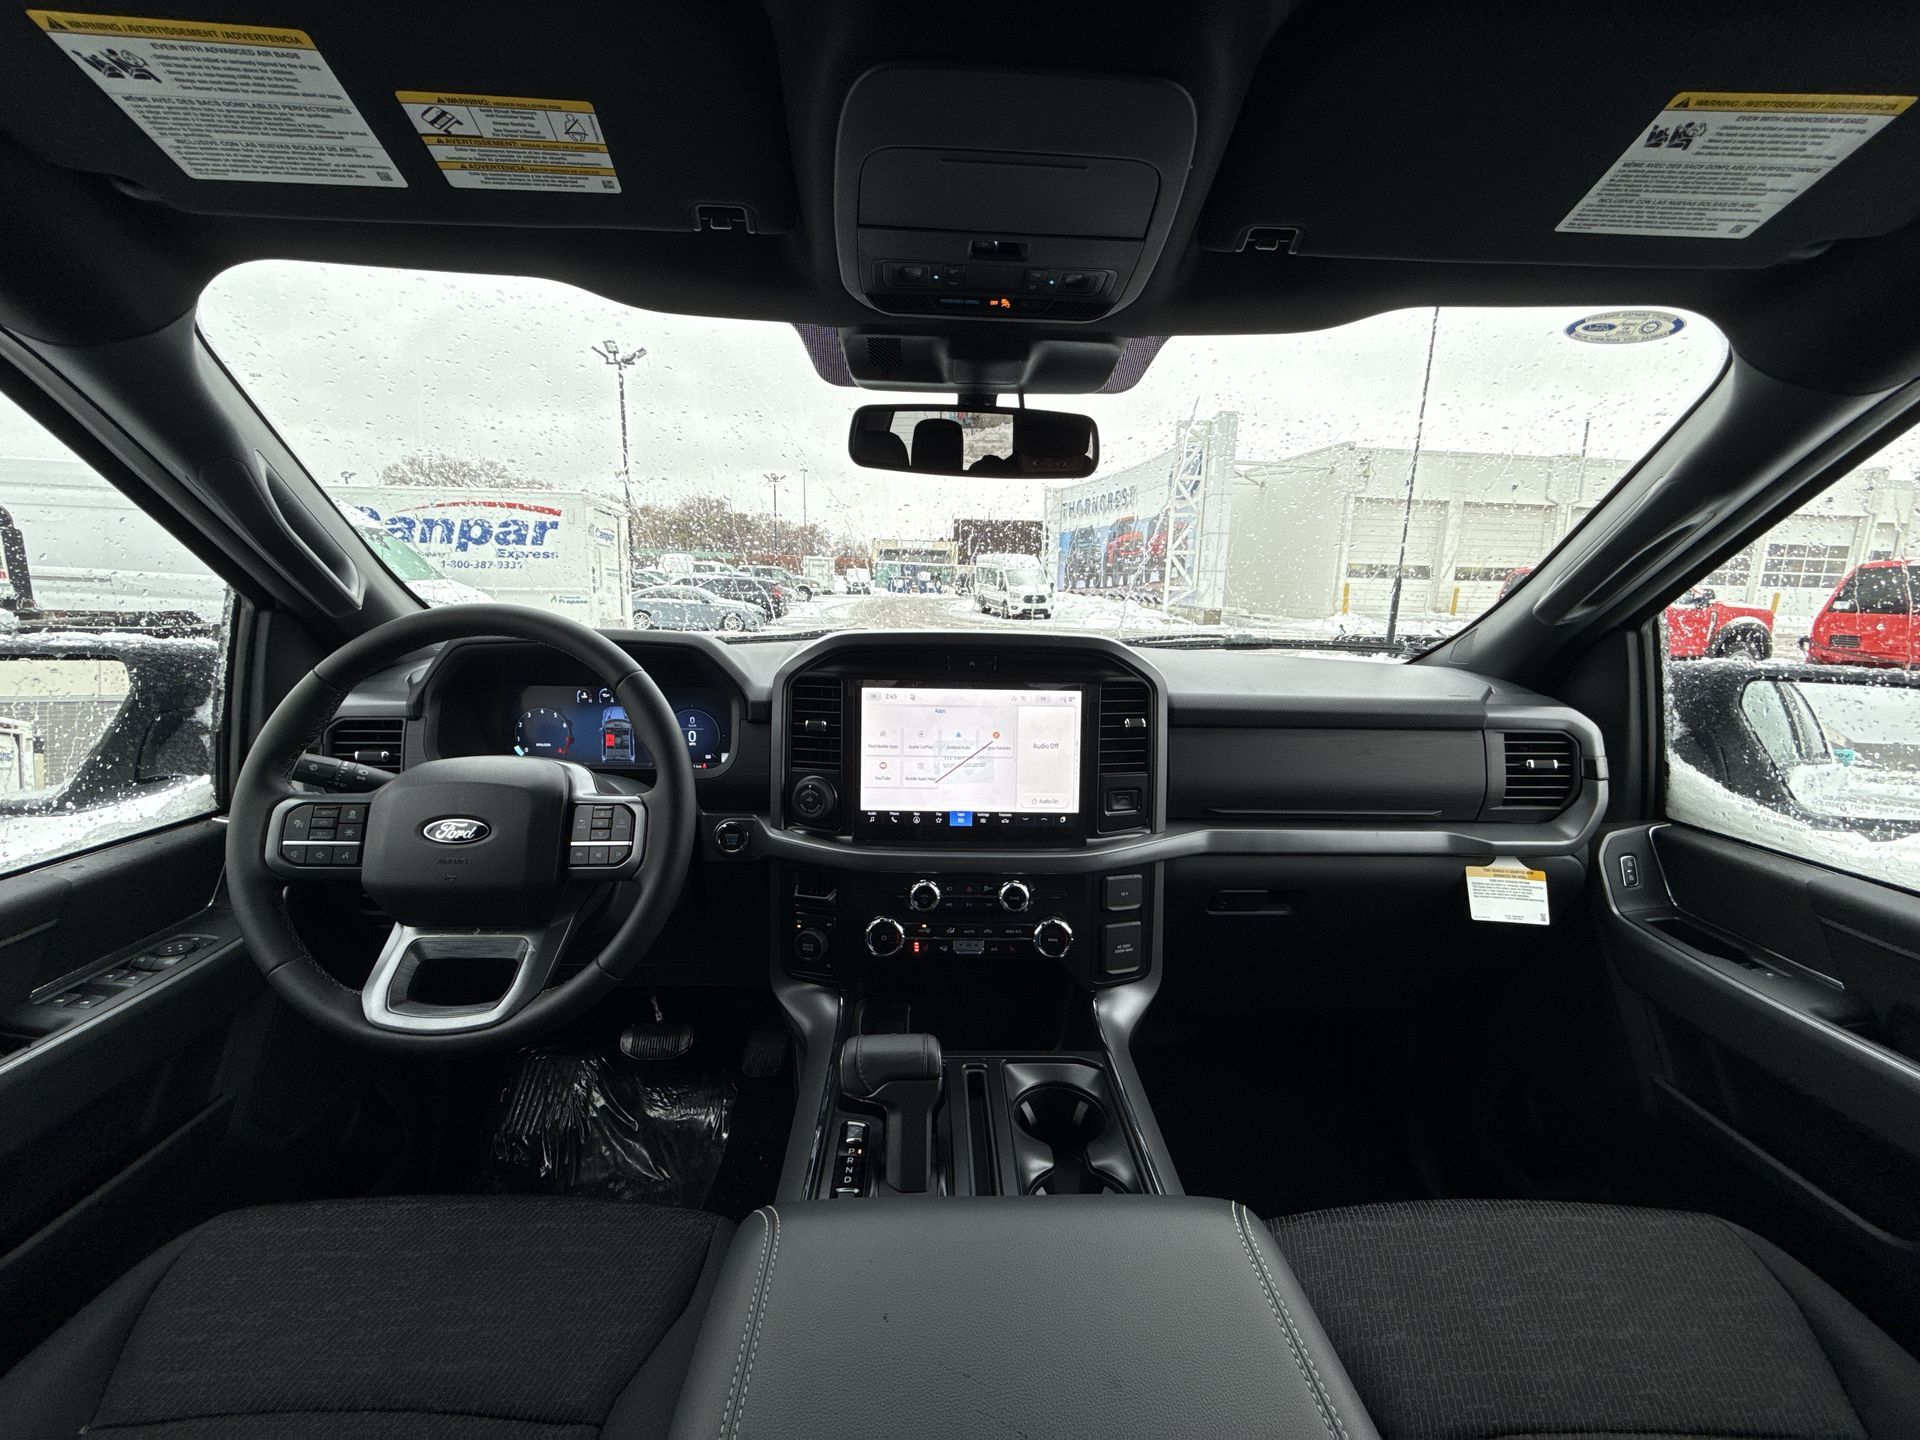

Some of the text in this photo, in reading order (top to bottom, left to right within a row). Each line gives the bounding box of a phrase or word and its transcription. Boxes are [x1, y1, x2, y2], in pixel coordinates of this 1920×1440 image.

[66, 20, 121, 32] WARNING
[150, 42, 178, 51] EVEN
[204, 46, 256, 56] ADVANCED
[1695, 99, 1739, 107] WARNING
[1062, 486, 1137, 518] THORNCREST
[497, 548, 560, 560] Express
[690, 716, 696, 724] 0
[688, 730, 696, 742] 0
[844, 1176, 852, 1184] D
